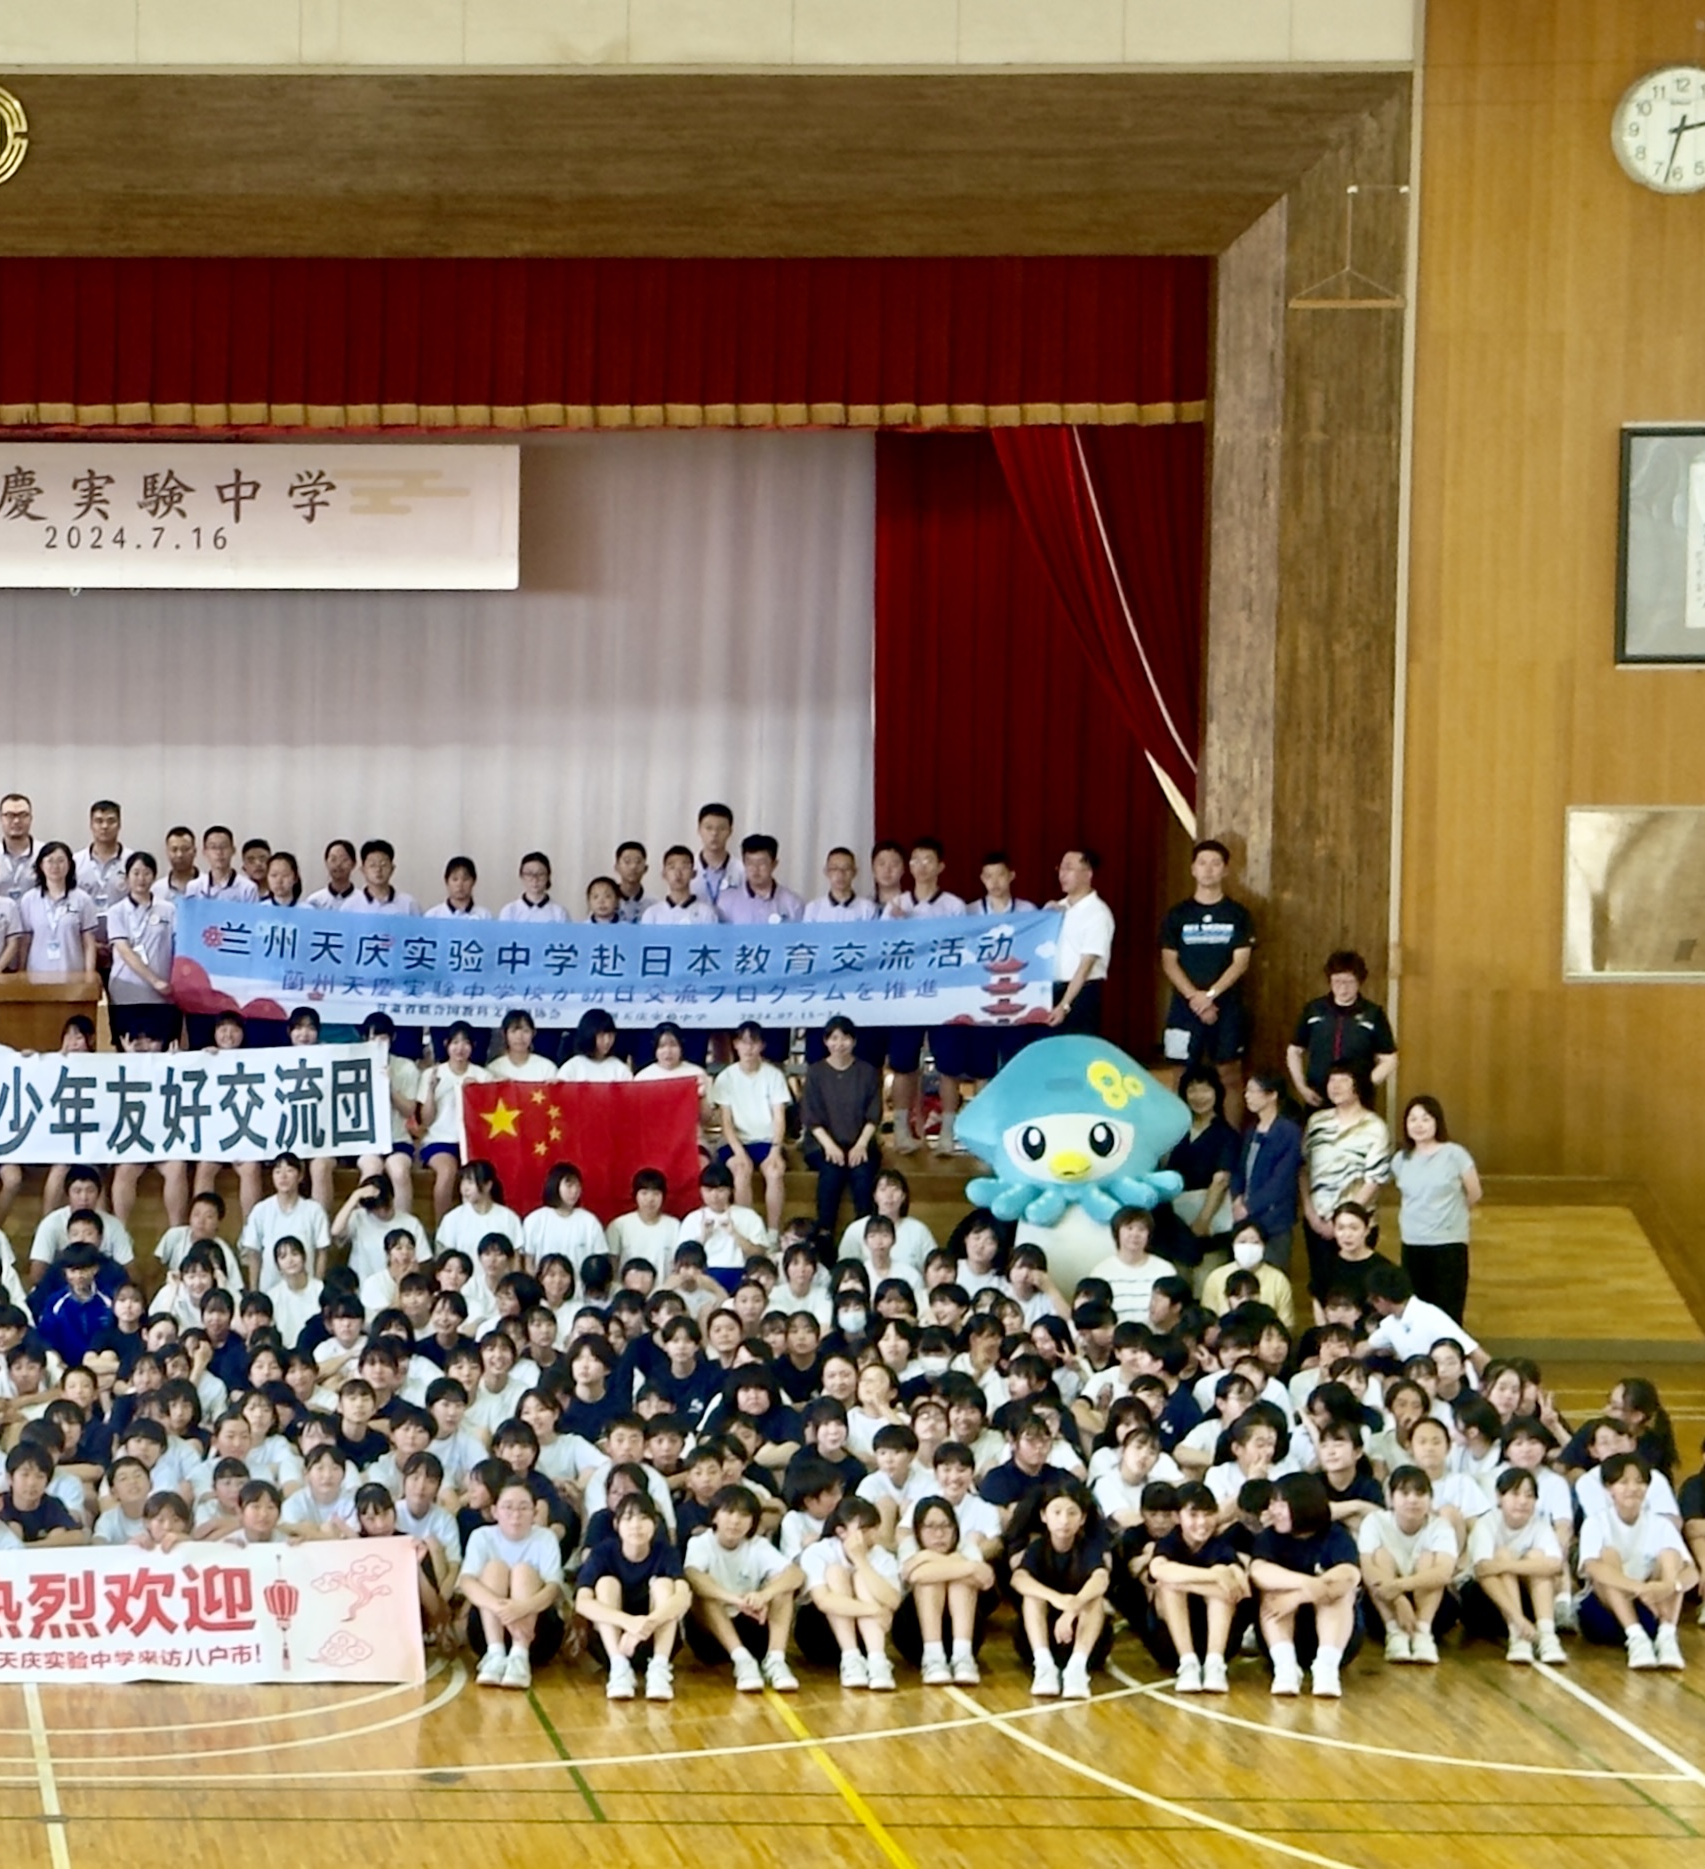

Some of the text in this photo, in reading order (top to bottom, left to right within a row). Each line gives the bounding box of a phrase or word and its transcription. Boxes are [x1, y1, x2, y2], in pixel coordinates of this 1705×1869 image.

[1652, 84, 1666, 99] 11
[1675, 77, 1691, 93] 12
[1636, 100, 1653, 117] 10
[1628, 122, 1640, 137] 9
[1635, 146, 1647, 161] 8
[1654, 161, 1664, 177] 7
[1672, 166, 1684, 181] 6
[44, 526, 230, 551] 2024.7.16
[219, 921, 1014, 977] 兰州天庆实验中学赴日本教育交流活动
